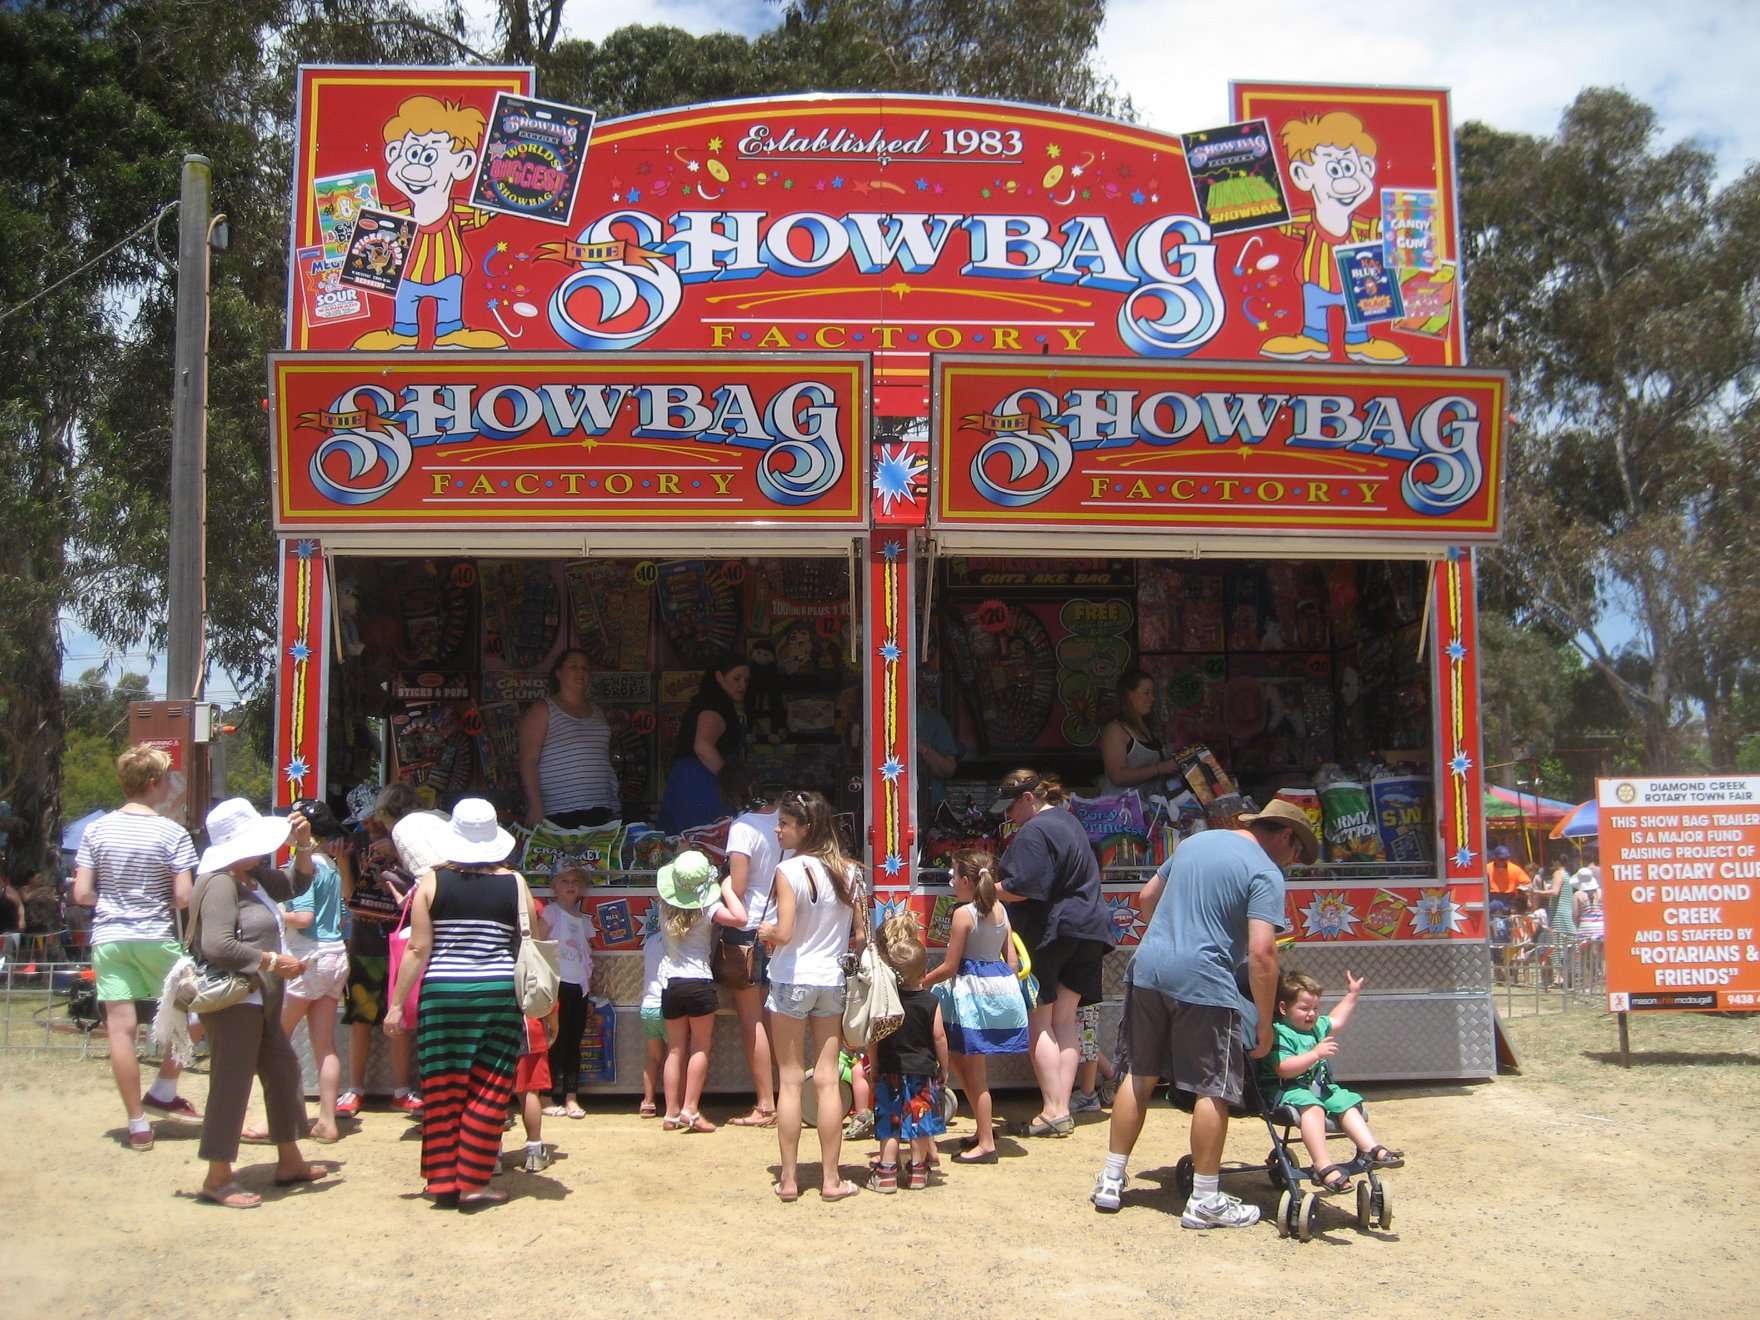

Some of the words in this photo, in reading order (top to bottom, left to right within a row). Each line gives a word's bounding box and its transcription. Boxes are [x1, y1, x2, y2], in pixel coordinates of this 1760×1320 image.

[736, 125, 929, 157] Established
[942, 128, 1024, 157] 1983
[491, 160, 568, 192] BIGGEST
[497, 182, 552, 206] SHOWBAG
[1209, 203, 1282, 224] SHOWBAG
[1390, 218, 1432, 230] CANDY
[1396, 238, 1428, 249] GUM
[573, 245, 620, 262] THE
[548, 210, 1226, 357] SHOWBAG
[316, 289, 357, 306] SOUR
[325, 413, 363, 428] THE
[987, 416, 1026, 431] THE
[308, 381, 844, 505] SHOWBAG
[969, 388, 1484, 514] SHOWBAG
[1071, 603, 1120, 621] FREE
[1650, 782, 1705, 792] DIAMOND
[1710, 781, 1747, 791] CREEK
[1645, 793, 1688, 802] ROTARY
[1691, 792, 1725, 801] TOWN
[1729, 791, 1753, 801] FAIR
[1611, 816, 1637, 828] THIS
[1640, 815, 1679, 828] SHOW
[1682, 814, 1709, 827] BAG
[1712, 813, 1760, 826] TRAILER
[1631, 832, 1642, 844] IS
[1646, 831, 1655, 843] A
[1658, 830, 1703, 843] MAJOR
[1707, 829, 1743, 842] FUND
[1621, 847, 1673, 860] RAISING
[1676, 845, 1733, 858] PROJECT
[1737, 844, 1756, 857] OF
[1611, 864, 1642, 881] THE
[1648, 863, 1715, 880] ROTARY
[1631, 887, 1656, 903] OF
[1661, 884, 1750, 902] DIAMOND
[1663, 907, 1722, 925] CREEK
[1635, 930, 1663, 943] AND
[1666, 930, 1678, 942] IS
[1682, 928, 1734, 942] STAFFED
[1737, 928, 1753, 940] BY
[1746, 945, 1760, 962] &
